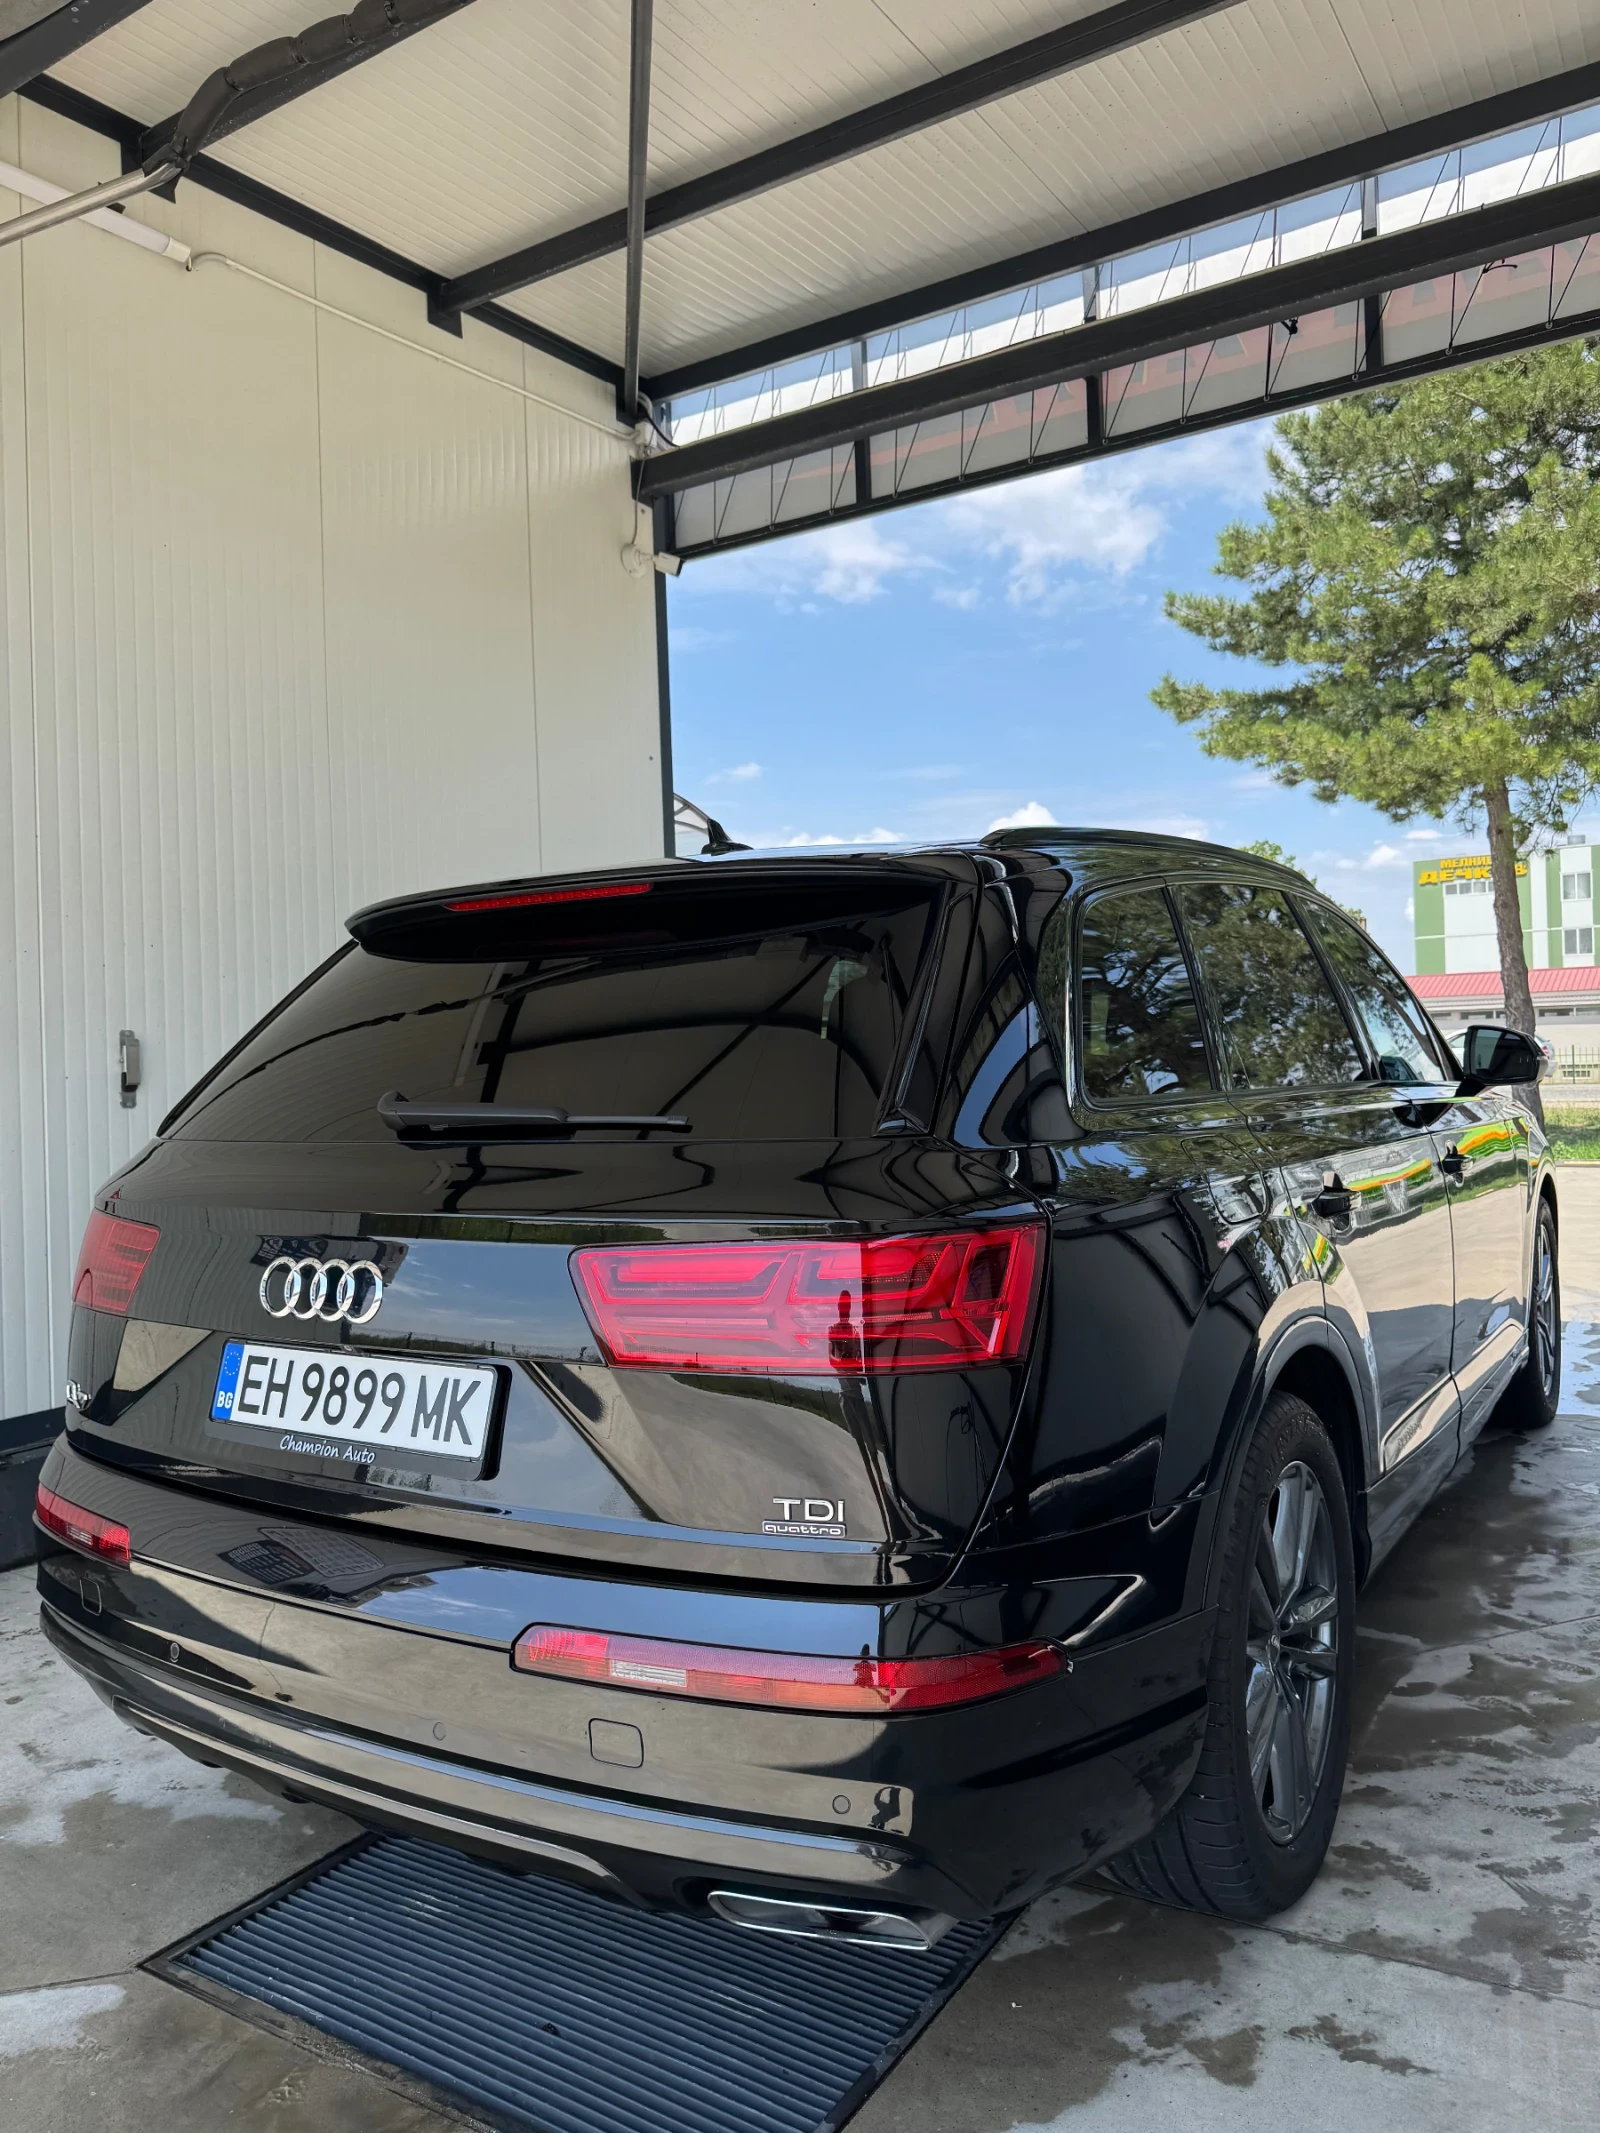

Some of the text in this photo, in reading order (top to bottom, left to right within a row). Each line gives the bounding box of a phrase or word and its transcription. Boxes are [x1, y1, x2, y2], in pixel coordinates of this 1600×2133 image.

[1419, 864, 1528, 885] ДЕЧКВ
[216, 1390, 233, 1409] BG
[237, 1354, 481, 1446] EH 9899 MK
[279, 1435, 376, 1464] Champion Auto
[772, 1497, 845, 1522] TDI
[764, 1523, 842, 1536] quattro
